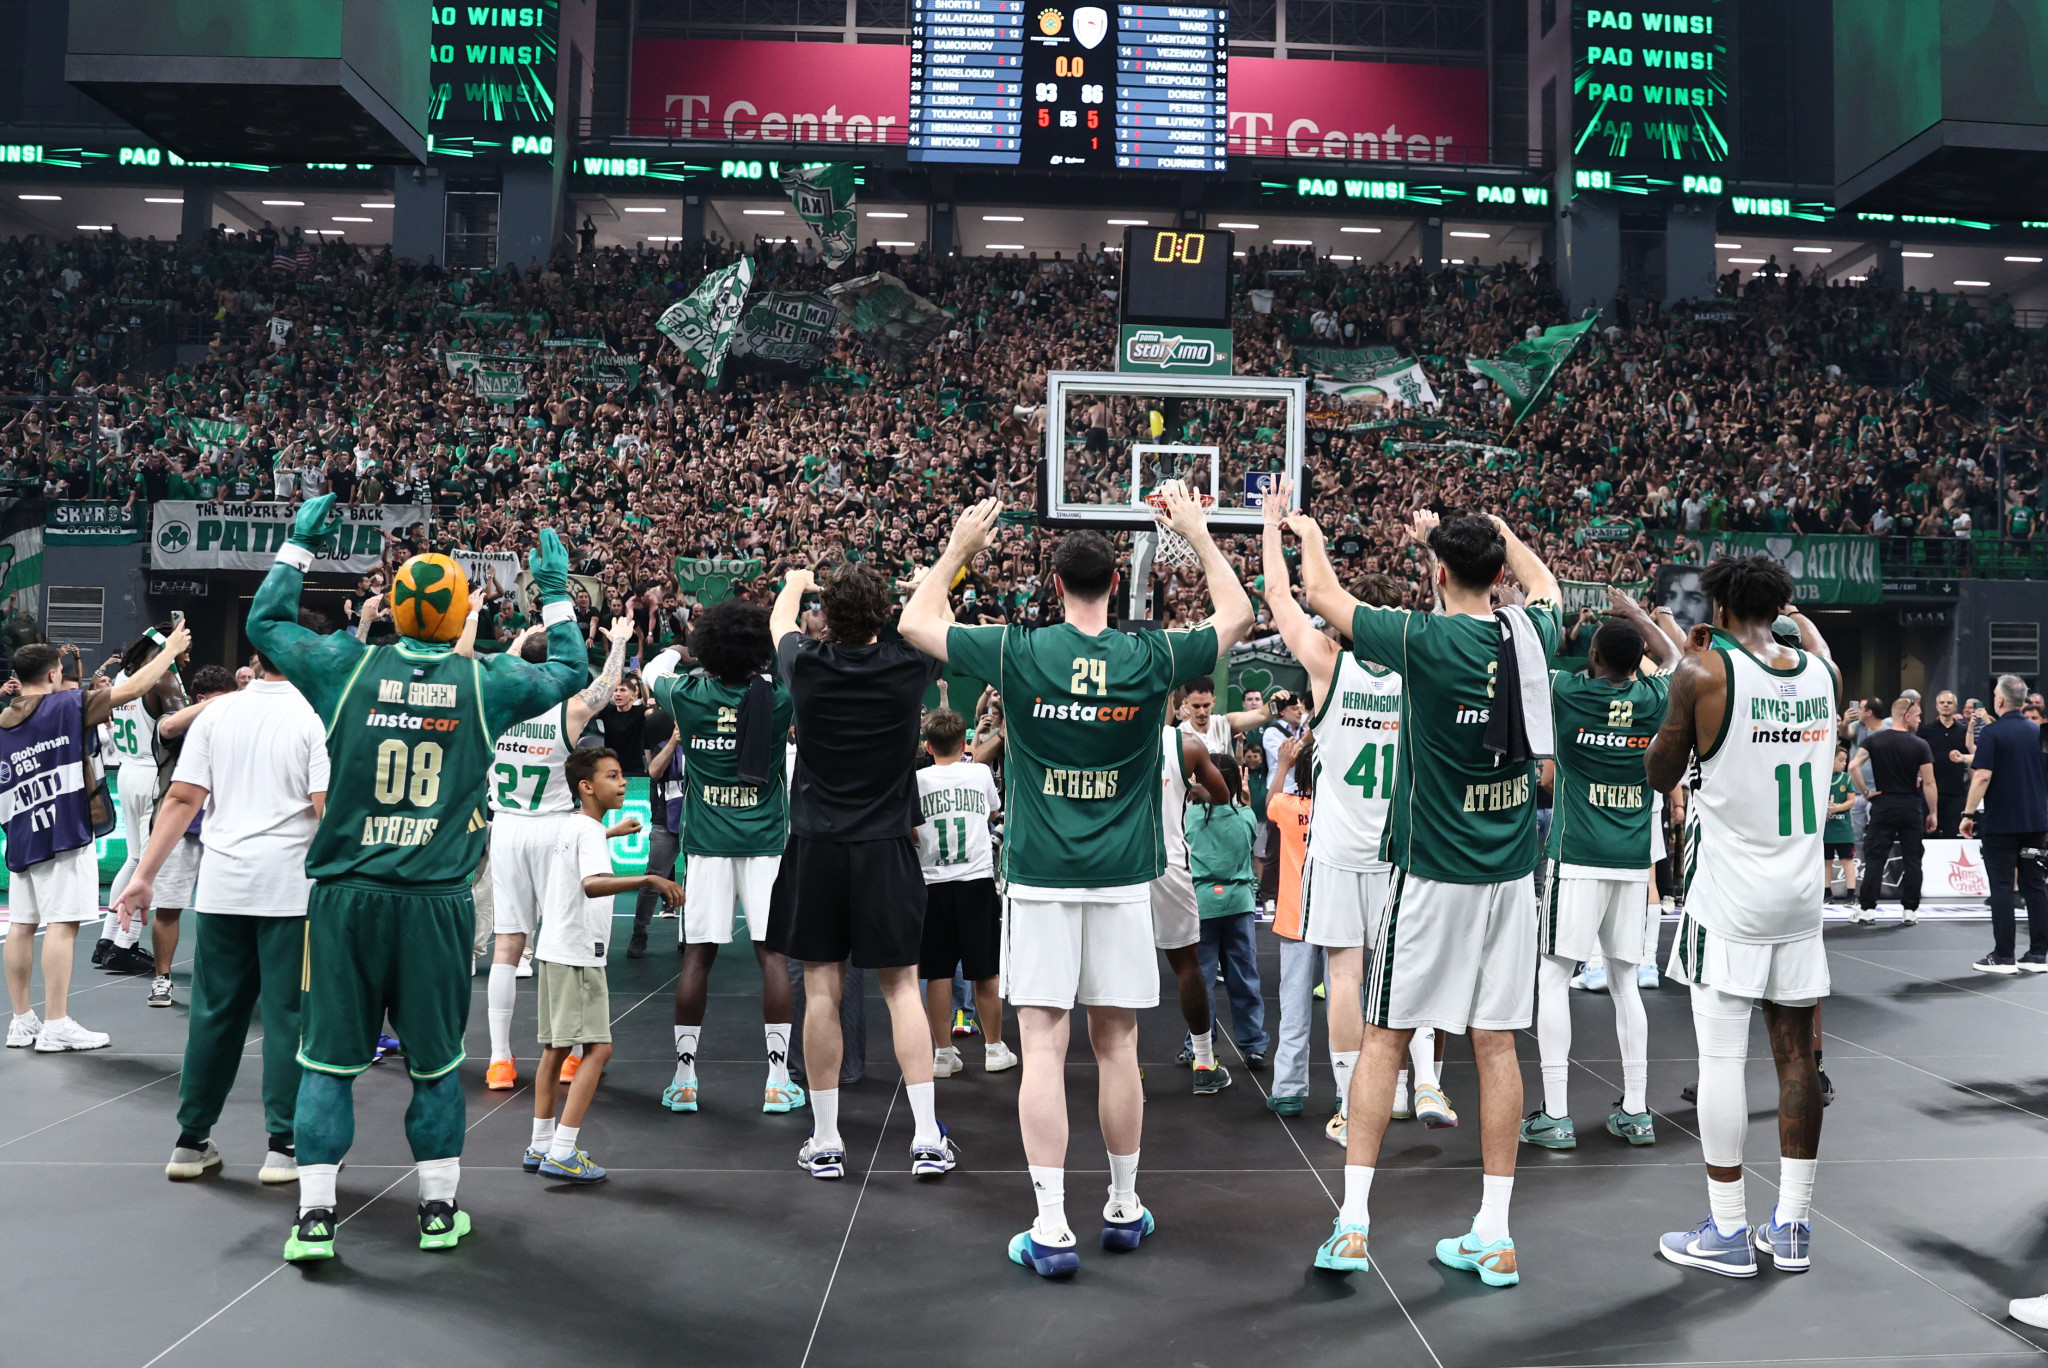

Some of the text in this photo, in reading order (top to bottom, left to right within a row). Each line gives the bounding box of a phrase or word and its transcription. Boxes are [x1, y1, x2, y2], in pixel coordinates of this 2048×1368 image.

[934, 0, 973, 10] SHORTS
[1010, 3, 1020, 11] 13
[1122, 7, 1132, 15] 19
[1168, 8, 1208, 18] WALKUP
[467, 7, 543, 27] WINS!
[934, 14, 995, 24] KALAITZAKIS
[1587, 10, 1714, 34] PAO WINS!
[913, 27, 1019, 38] 11 HAYES DAVIS 12
[1179, 22, 1208, 31] WARD
[1218, 24, 1225, 33] 3
[933, 40, 994, 51] SAMODUROV
[1146, 34, 1207, 45] LARENTZAKIS
[466, 45, 541, 65] WINS!
[912, 54, 966, 64] 22 GRANT
[1121, 47, 1227, 60] 14 VEZENKOV 14
[1587, 47, 1714, 71] PAO WINS!
[911, 68, 995, 79] 24 KOUZELOGLOU
[1055, 55, 1084, 78] 0.0
[1123, 61, 1129, 70] 7
[1145, 61, 1208, 73] PAPANIKOLAOU
[932, 82, 959, 91] NUNN
[1007, 85, 1018, 93] 23
[1145, 75, 1226, 87] NETZIPOGLOU 21
[464, 83, 539, 103] WINS!
[931, 96, 975, 105] LESSORT
[1036, 82, 1058, 103] 93
[1081, 84, 1104, 104] 86
[1122, 88, 1226, 101] 4 DORSEY 22
[1588, 83, 1714, 107] PAO WINS!
[910, 109, 1017, 121] 27 TOLIOPOULOS 11
[1122, 102, 1129, 111] 4
[1169, 104, 1205, 113] PETERS
[722, 100, 896, 144] Center
[1038, 108, 1050, 128] 5
[1060, 110, 1077, 128] E5
[1087, 110, 1099, 129] 5
[1121, 116, 1128, 124] 4
[1155, 117, 1205, 127] MILUTINOV
[909, 123, 993, 134] 41 HERNANGOMEZ
[1121, 130, 1128, 139] 2
[1168, 131, 1205, 141] JOSEPH
[511, 136, 553, 154] PAO
[909, 137, 980, 147] 44 MITOGLOU
[1091, 137, 1098, 150] 1
[1121, 144, 1128, 152] 2
[1174, 145, 1205, 155] JONES
[1286, 118, 1453, 163] Center
[118, 148, 161, 166] PAO
[1157, 158, 1205, 169] FOURNIER
[584, 157, 646, 177] WINS!
[721, 160, 763, 179] PAO
[1298, 178, 1338, 198] PAO
[1344, 180, 1406, 199] WINS!
[1477, 186, 1516, 205] PAO
[1683, 176, 1723, 195] PAO
[1732, 197, 1791, 216] WINS!
[195, 503, 219, 517] THE
[223, 505, 279, 519] EMPIRE
[350, 508, 384, 521] BACK
[315, 544, 350, 561] Club
[453, 550, 514, 562] KASTORIA
[1070, 657, 1107, 696] 24
[377, 679, 458, 708] MR. GREEN
[1032, 697, 1140, 722] instacar
[1608, 700, 1634, 728] 22
[1751, 696, 1829, 724] HAYES-DAVIS
[365, 708, 460, 732] instacar
[113, 717, 138, 755] 26
[1751, 725, 1829, 744] instacar
[10, 735, 70, 777] Stoiximan GBL
[374, 738, 444, 808] 08
[1343, 743, 1395, 800] 41
[494, 762, 551, 811] 27
[1042, 767, 1119, 800] ATHENS
[1463, 773, 1530, 813] ATHENS
[703, 784, 758, 808] ATHENS
[1588, 783, 1642, 808] ATHENS
[1774, 761, 1817, 836] 11
[361, 816, 438, 847] ATHENS
[934, 817, 969, 867] 11
